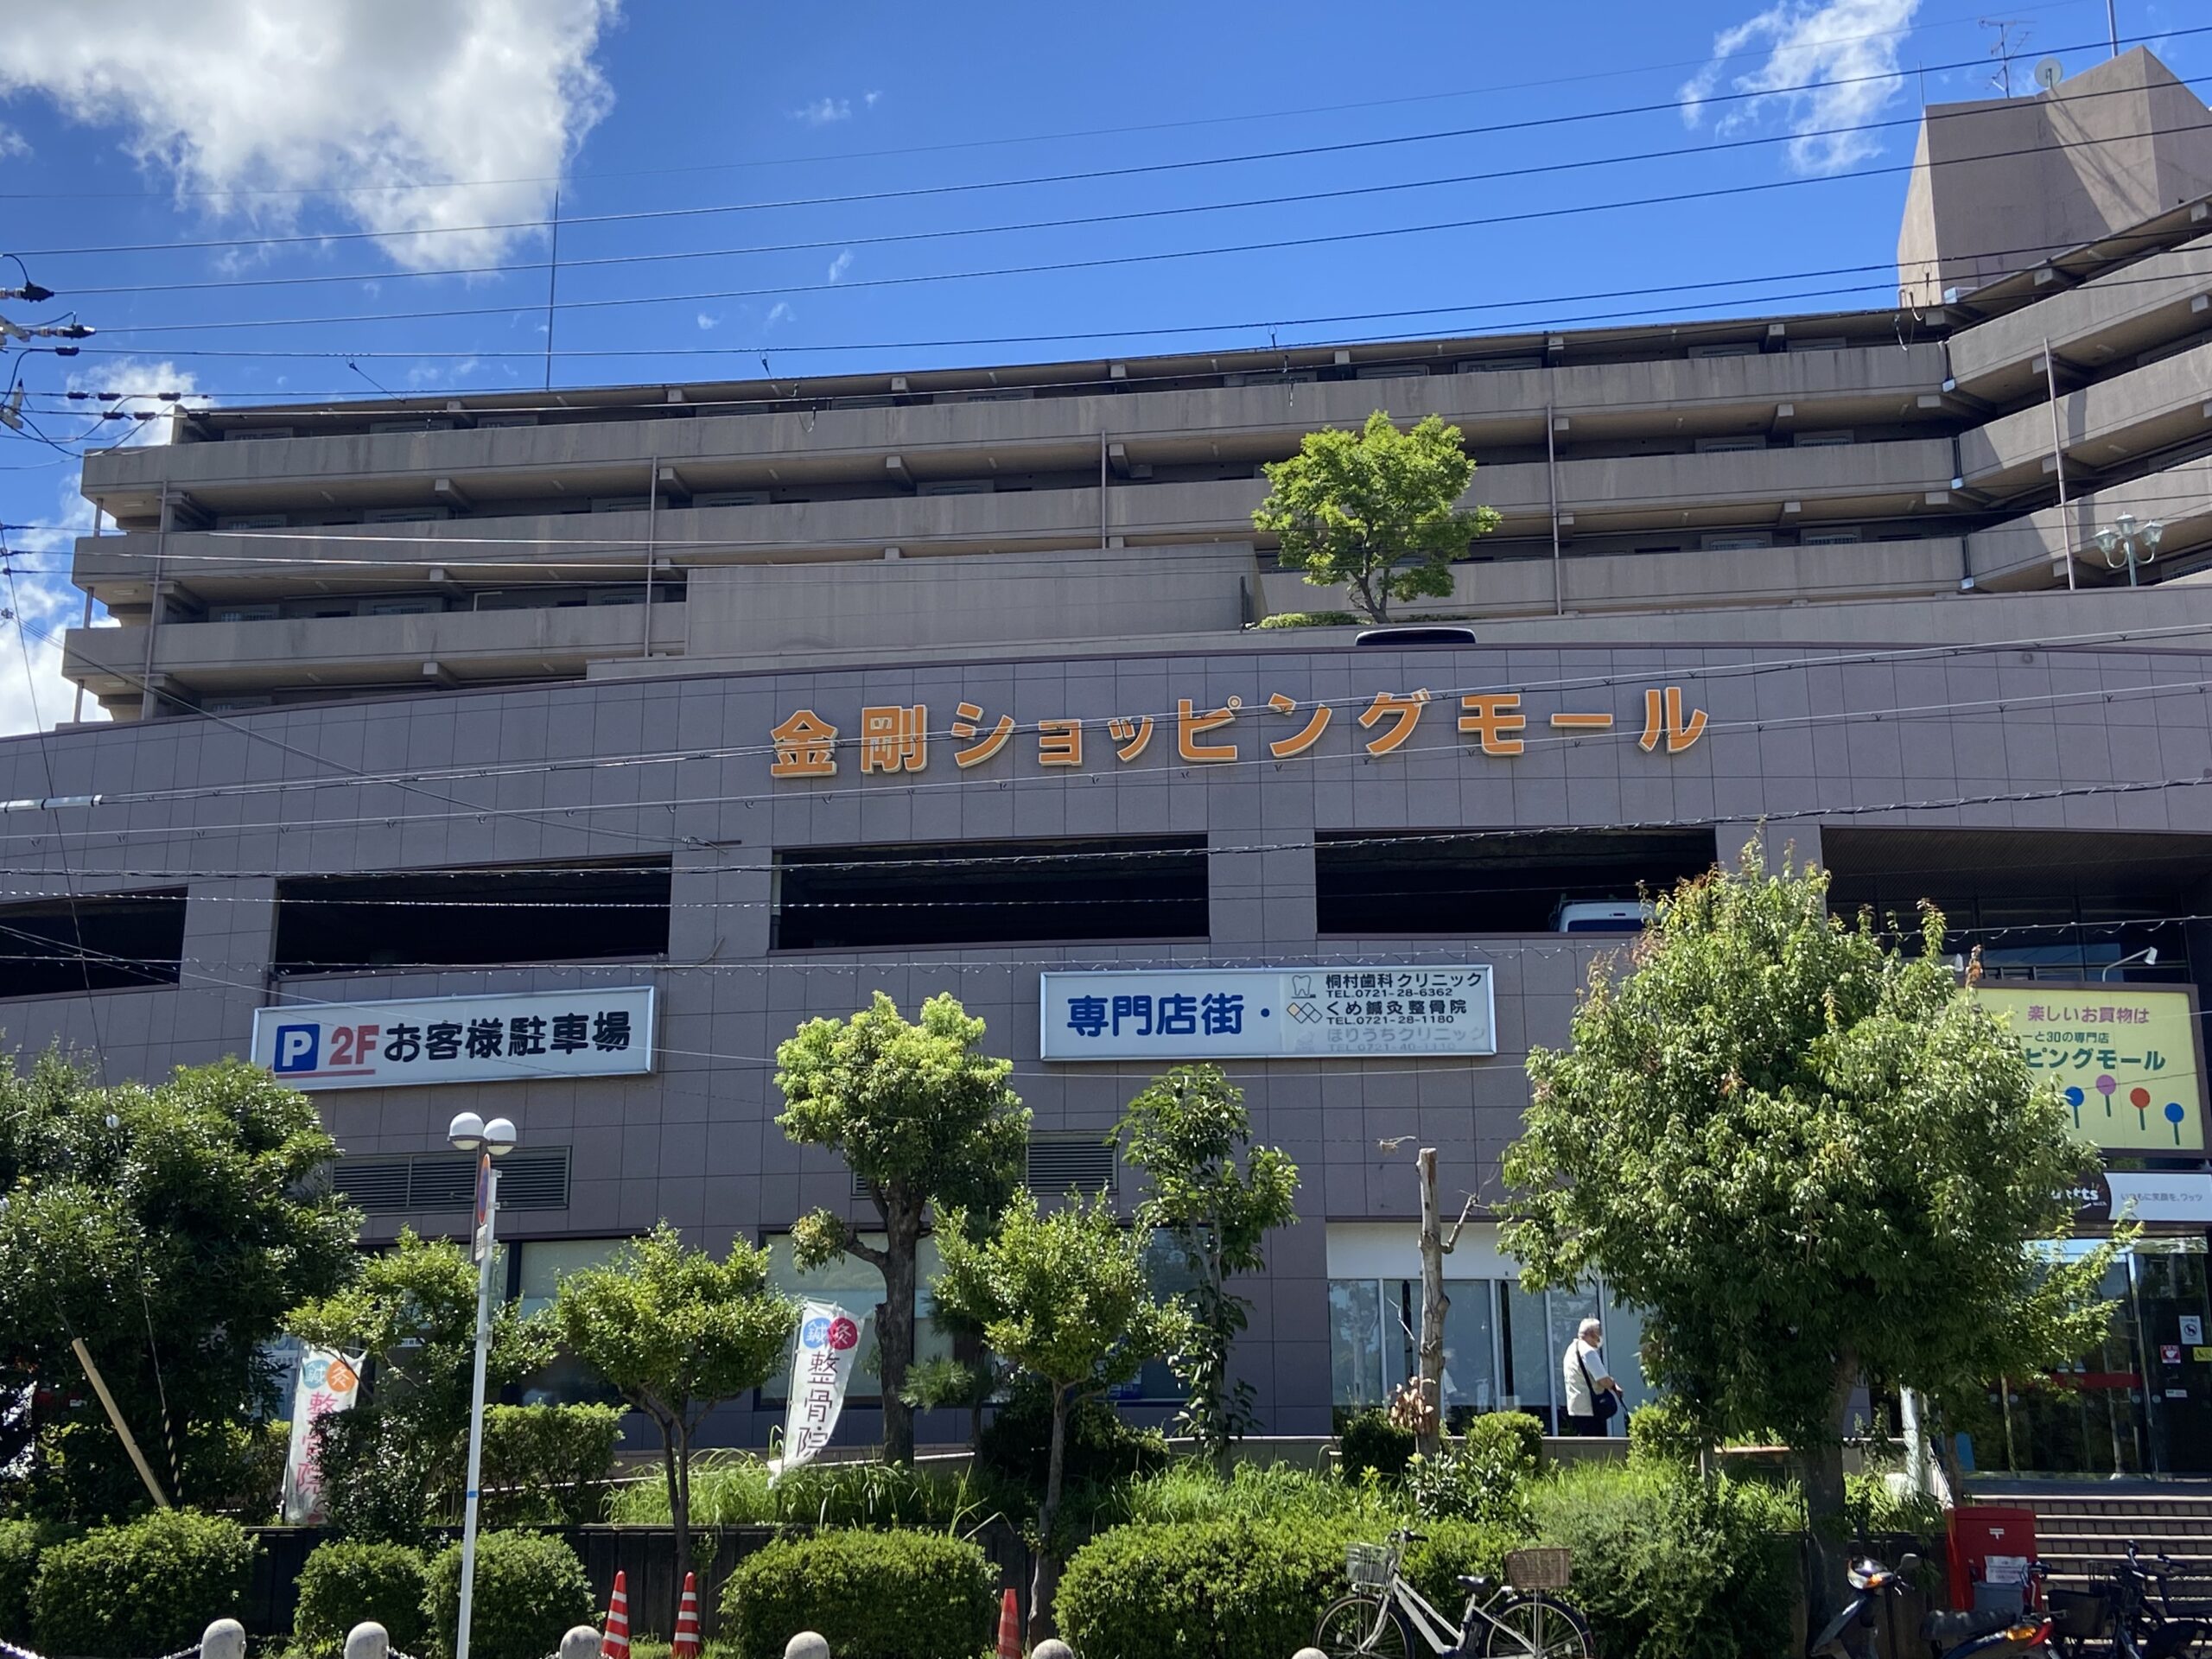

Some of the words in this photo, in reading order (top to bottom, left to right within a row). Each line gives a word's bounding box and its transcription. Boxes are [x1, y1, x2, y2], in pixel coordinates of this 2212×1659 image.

[770, 687, 1711, 779] 金剛ショッピングモール
[1326, 999, 1468, 1016] くめ鍼灸整骨院
[2027, 1005, 2150, 1024] 楽しいお買物は
[329, 1024, 380, 1065] 2F
[384, 1010, 632, 1063] お客様駐車場
[1327, 1027, 1486, 1043] ほりうちクリニック
[2006, 1031, 2109, 1045] ーと30の専門店
[796, 1351, 841, 1459] 整骨院
